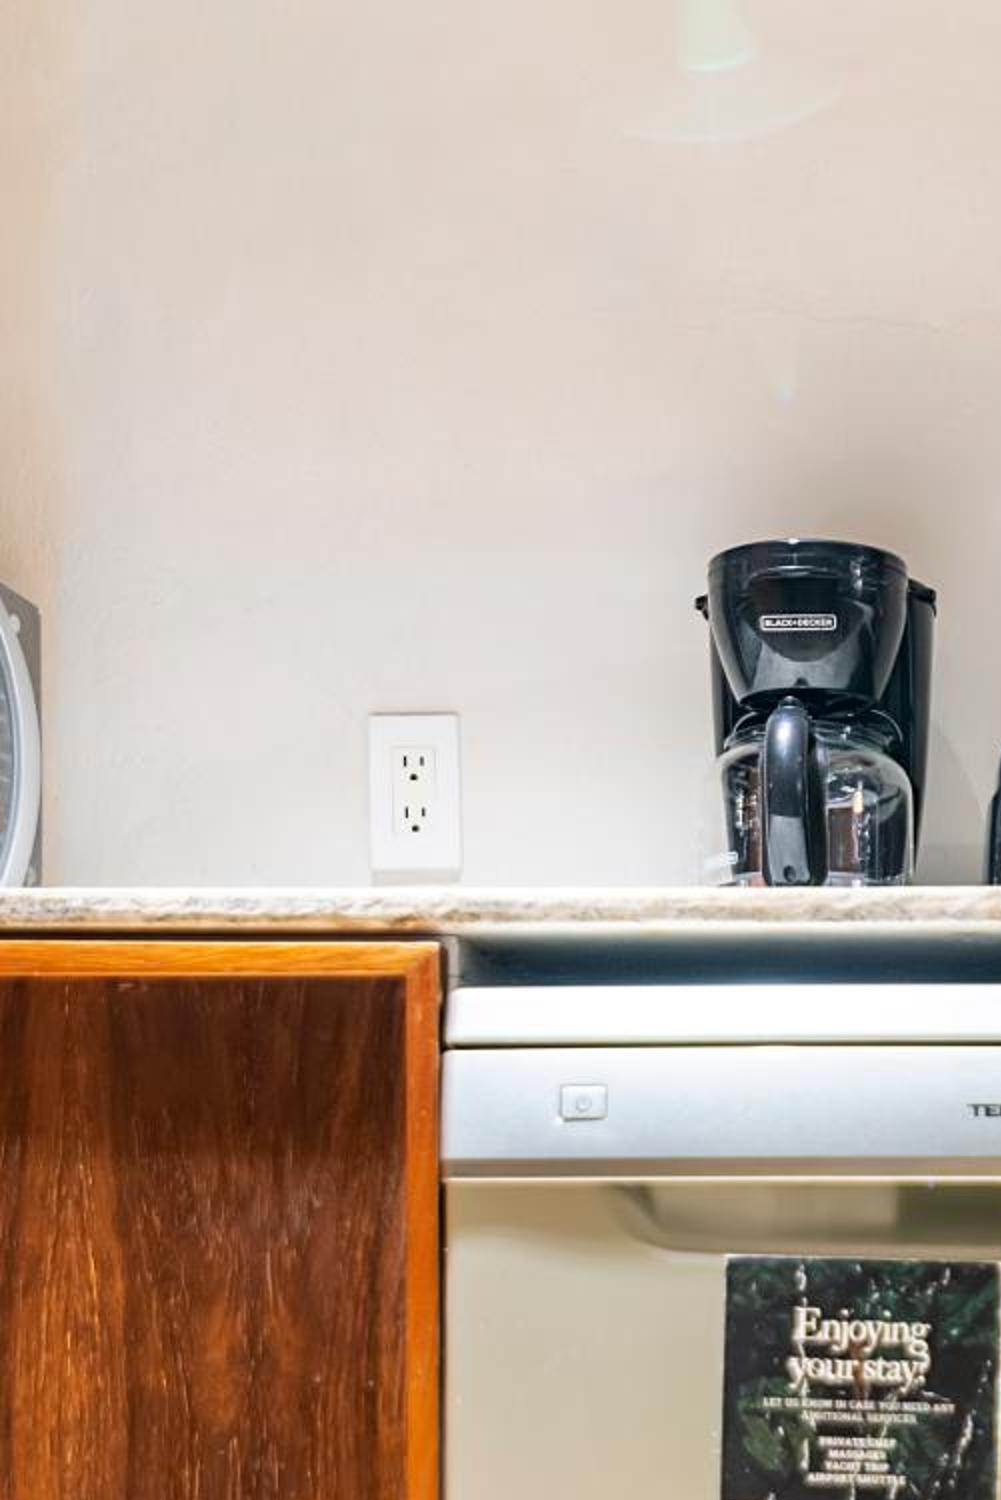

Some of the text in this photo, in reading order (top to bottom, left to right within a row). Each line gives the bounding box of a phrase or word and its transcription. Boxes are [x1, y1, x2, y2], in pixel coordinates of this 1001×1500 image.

[793, 1305, 931, 1361] Enjoying
[787, 1356, 855, 1390] your
[763, 1397, 782, 1408] LET
[785, 1397, 799, 1409] US
[801, 1398, 833, 1409] KNOW
[835, 1399, 847, 1409] IN
[849, 1400, 875, 1410] CASE
